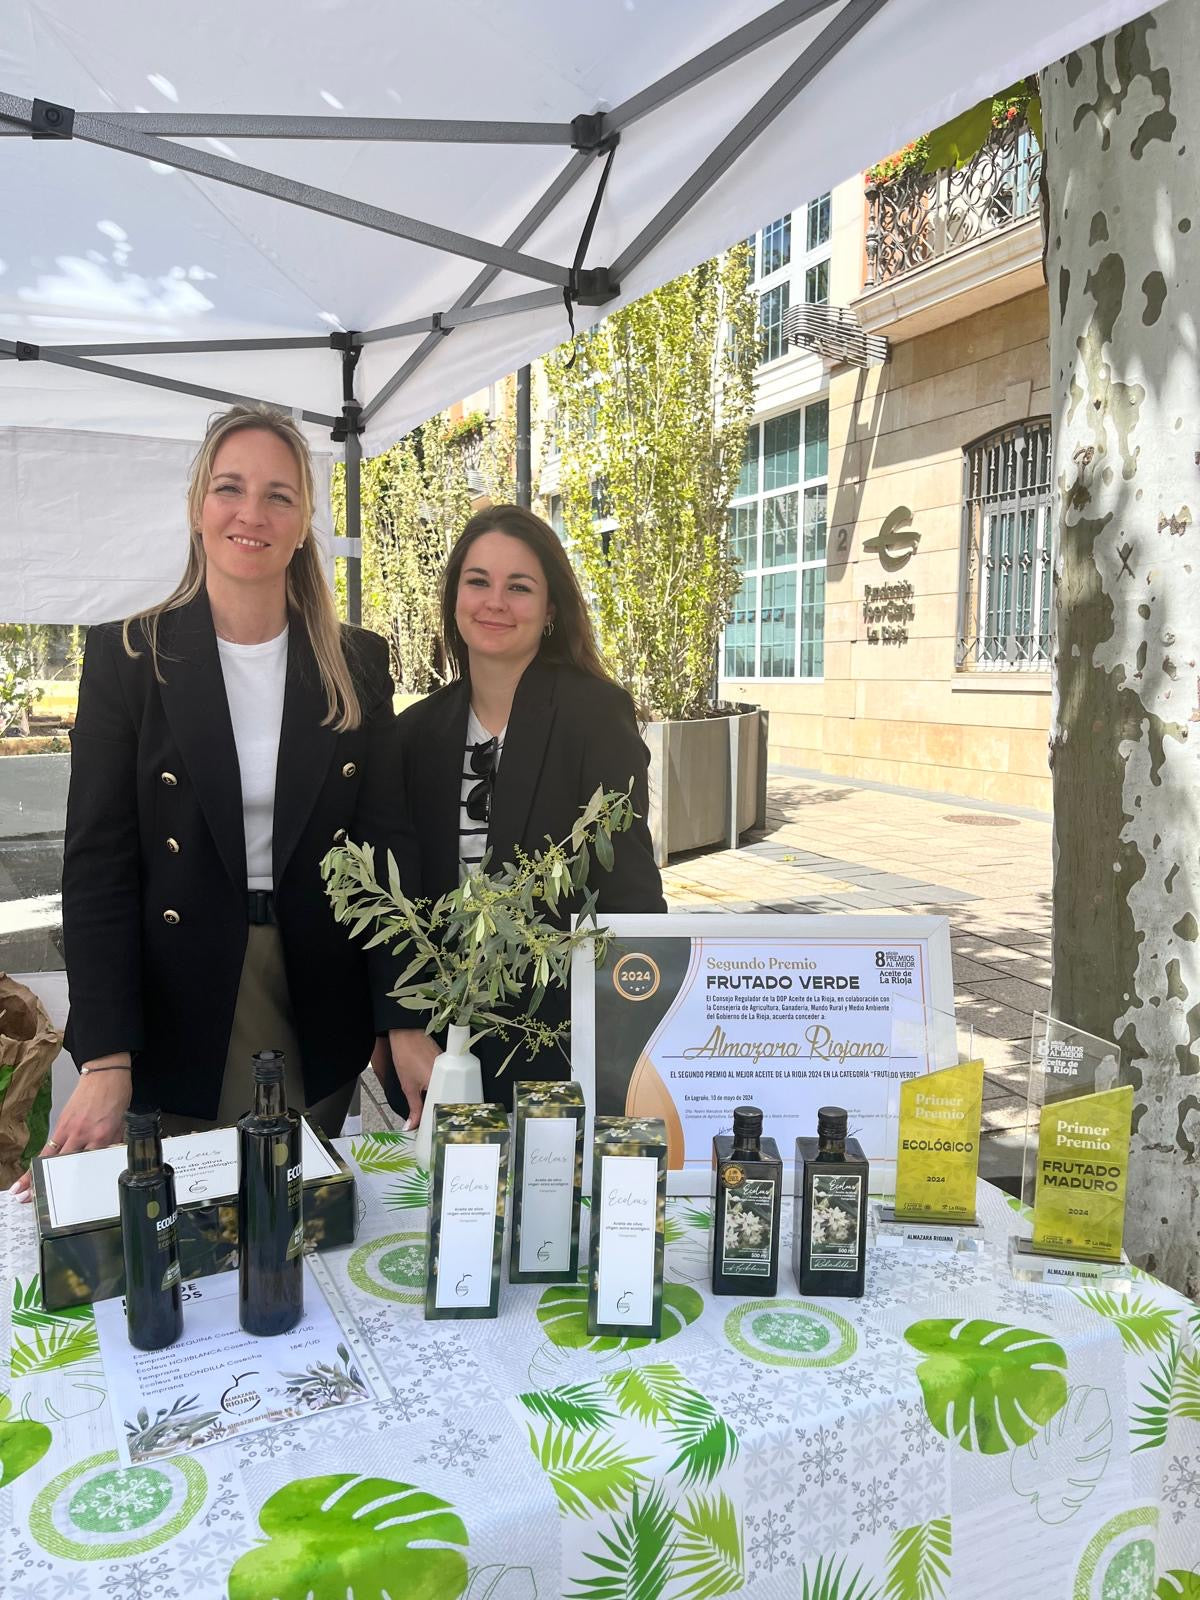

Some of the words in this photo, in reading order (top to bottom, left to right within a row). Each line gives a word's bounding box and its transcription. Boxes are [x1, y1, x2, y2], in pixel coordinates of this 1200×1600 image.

[838, 529, 847, 551] 2
[707, 957, 765, 971] Segundo
[769, 957, 817, 970] Premio
[875, 951, 885, 967] 8
[621, 971, 650, 981] 2024
[707, 976, 792, 989] FRUTADO
[799, 976, 860, 989] VERDE
[892, 977, 912, 985] Rioja
[713, 995, 733, 1003] Consejo
[735, 995, 761, 1003] Regulador
[683, 1025, 801, 1064] Almazara
[805, 1025, 888, 1064] Riojana
[1038, 1040, 1049, 1055] 8
[1051, 1045, 1083, 1053] PREMIOS
[1061, 1051, 1083, 1059] MEJOR
[840, 1069, 869, 1078] CATEGORÍA
[1054, 1066, 1077, 1075] Rioja
[916, 1093, 963, 1107] Primer
[915, 1107, 965, 1120] Premio
[1057, 1121, 1110, 1136] Primer
[902, 1138, 973, 1153] ECOLÓGICO
[1056, 1135, 1111, 1150] Premio
[1042, 1160, 1121, 1178] FRUTADO
[1043, 1174, 1118, 1192] MADURO
[1047, 1268, 1074, 1277] ALMAZARA
[135, 1353, 176, 1366] Temprana
[137, 1363, 167, 1374] Ecoleus
[139, 1368, 180, 1381] Temprana
[174, 1363, 225, 1381] REDONDILLA
[142, 1383, 184, 1397] Temprana
[225, 1390, 257, 1402] ALMAZARA
[226, 1394, 260, 1408] RIOJANA
